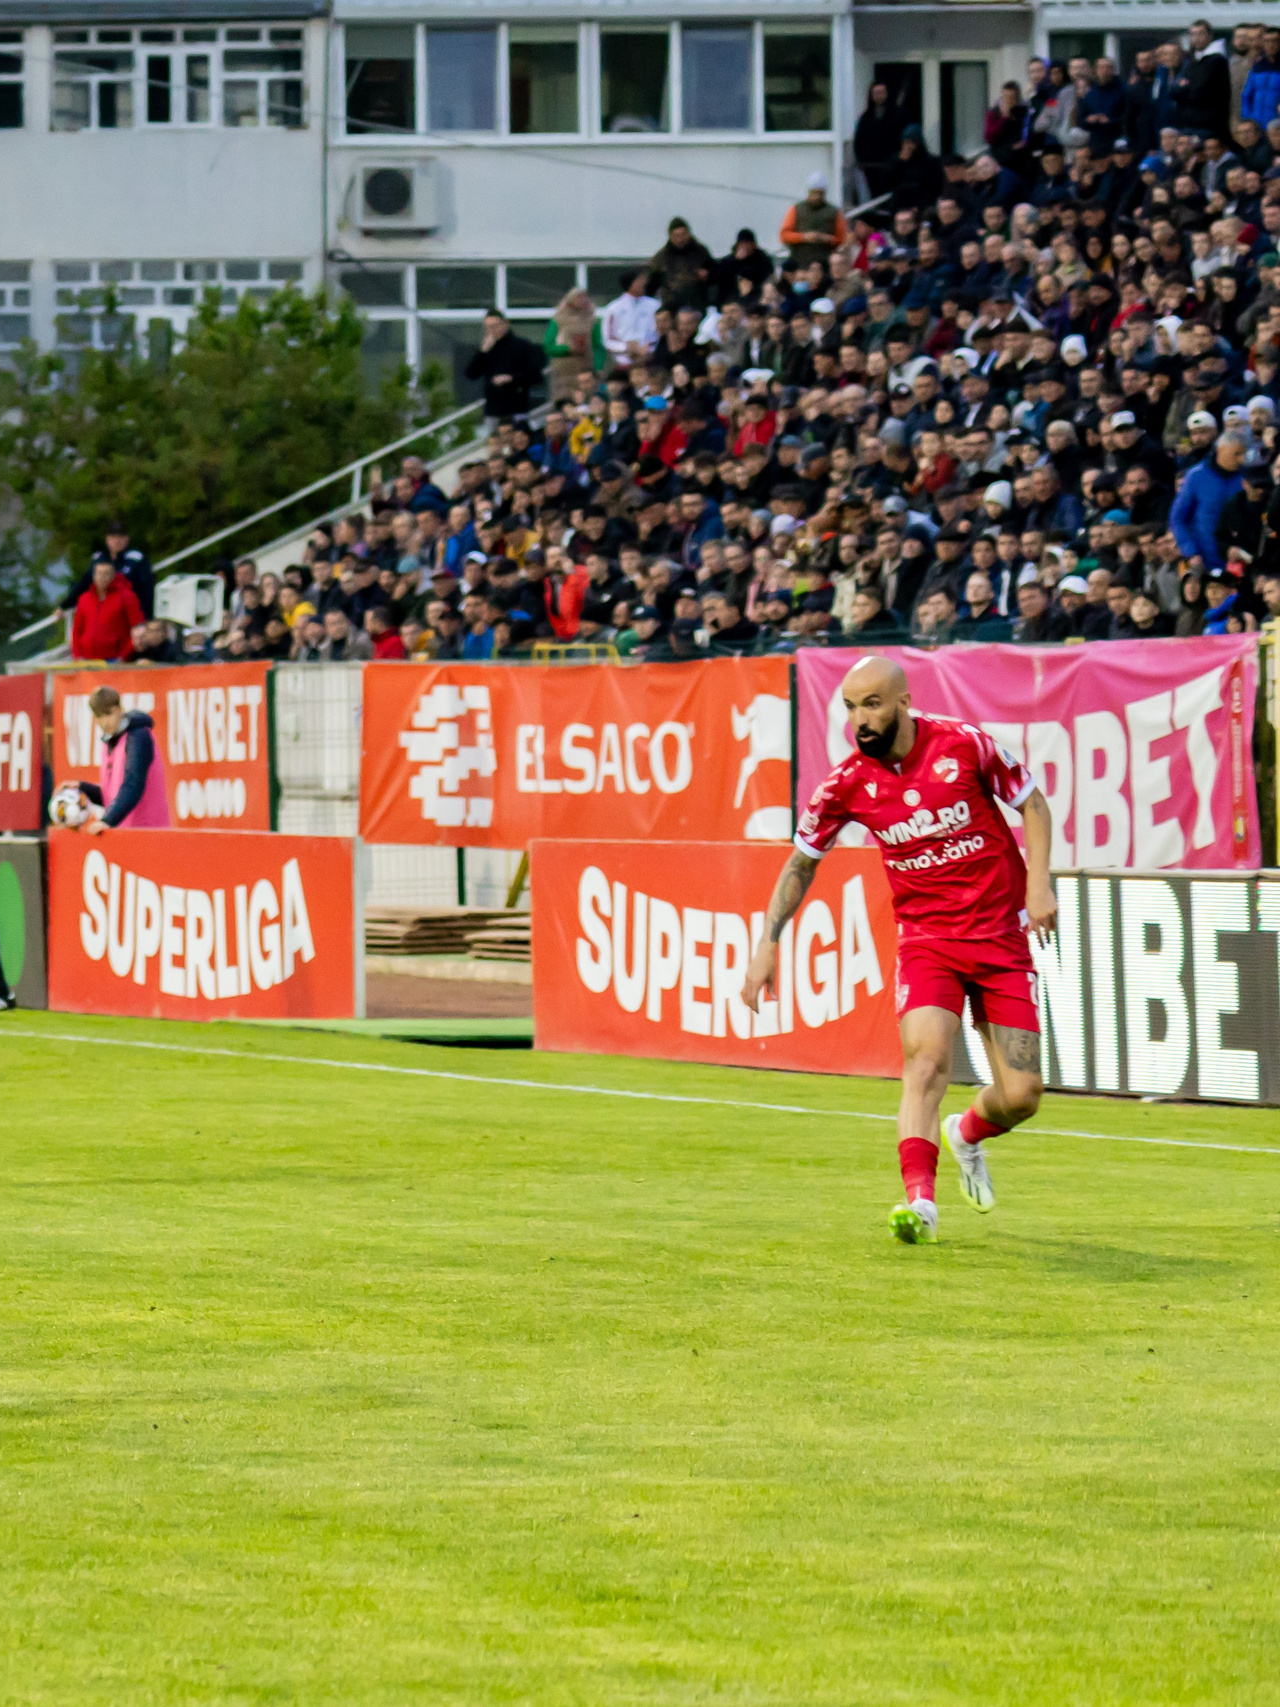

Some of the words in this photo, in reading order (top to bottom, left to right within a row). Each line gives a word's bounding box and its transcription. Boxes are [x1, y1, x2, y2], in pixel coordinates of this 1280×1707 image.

[167, 686, 262, 764] UNIBET
[516, 721, 694, 794] ELSACO
[80, 849, 316, 1000] SUPERLIGA
[575, 865, 884, 1040] SUPERLIGA
